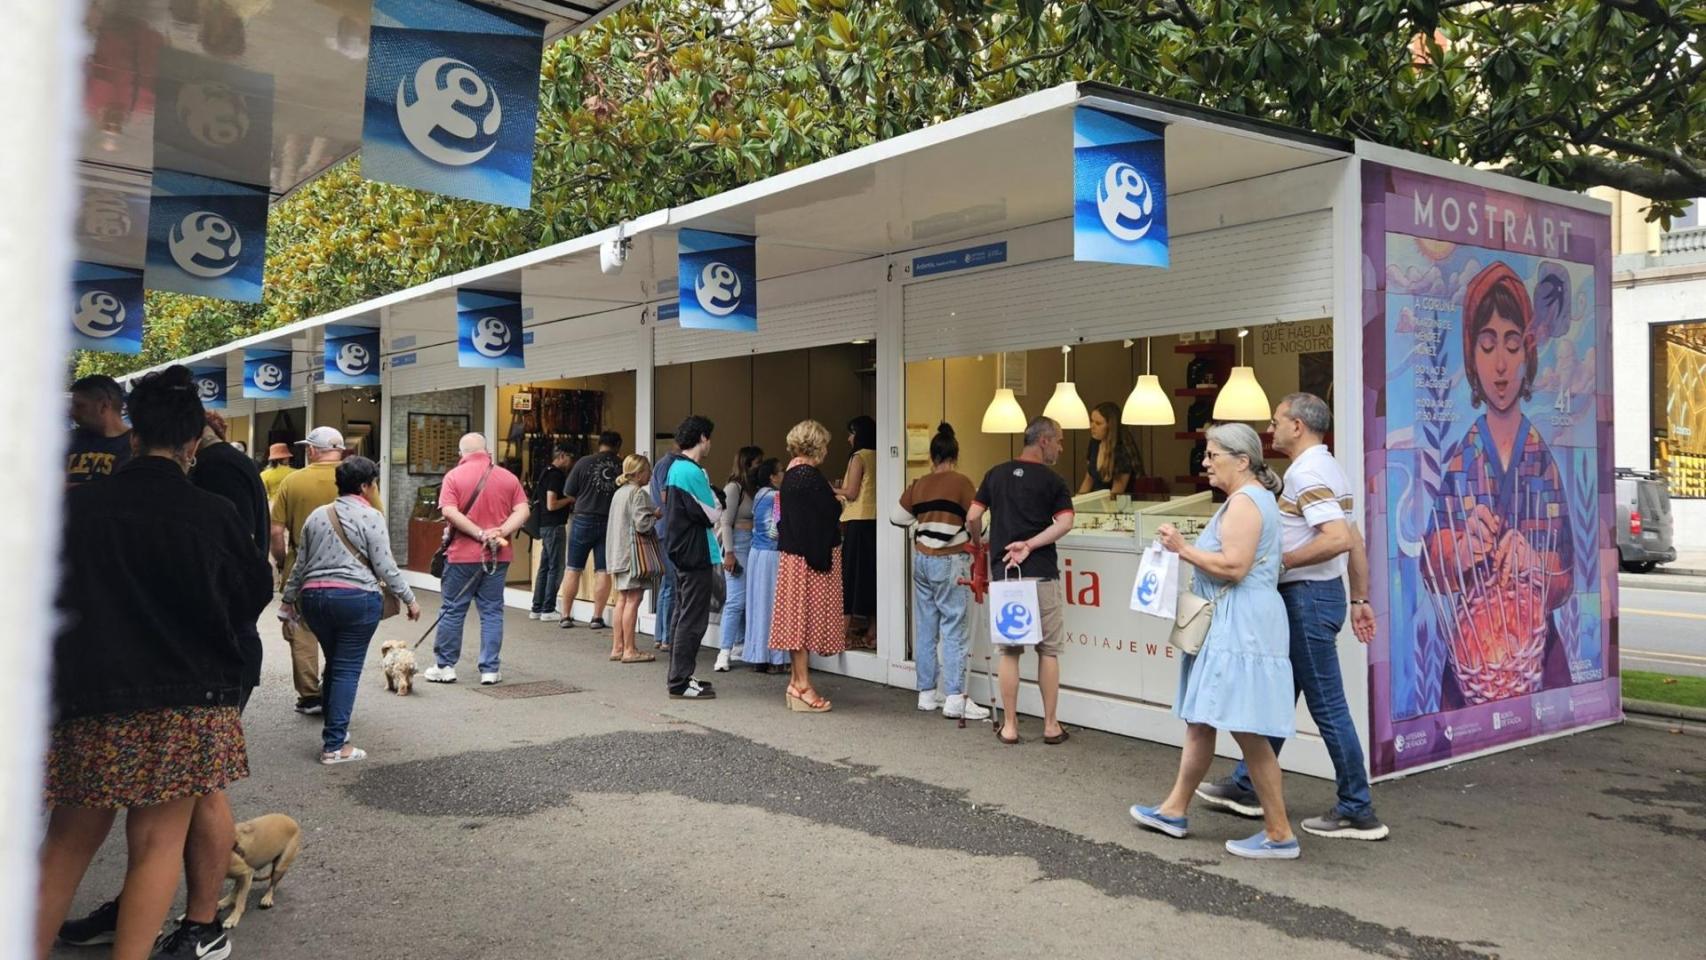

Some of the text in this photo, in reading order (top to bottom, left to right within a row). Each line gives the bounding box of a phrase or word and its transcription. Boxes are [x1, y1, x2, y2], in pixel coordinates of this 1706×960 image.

[1414, 188, 1573, 253] MOSTRART
[1263, 328, 1284, 342] QUE
[1288, 324, 1333, 339] HABLAN
[1263, 337, 1333, 355] DE NOSOTRO
[1554, 386, 1571, 413] 41
[1065, 558, 1100, 608] ia
